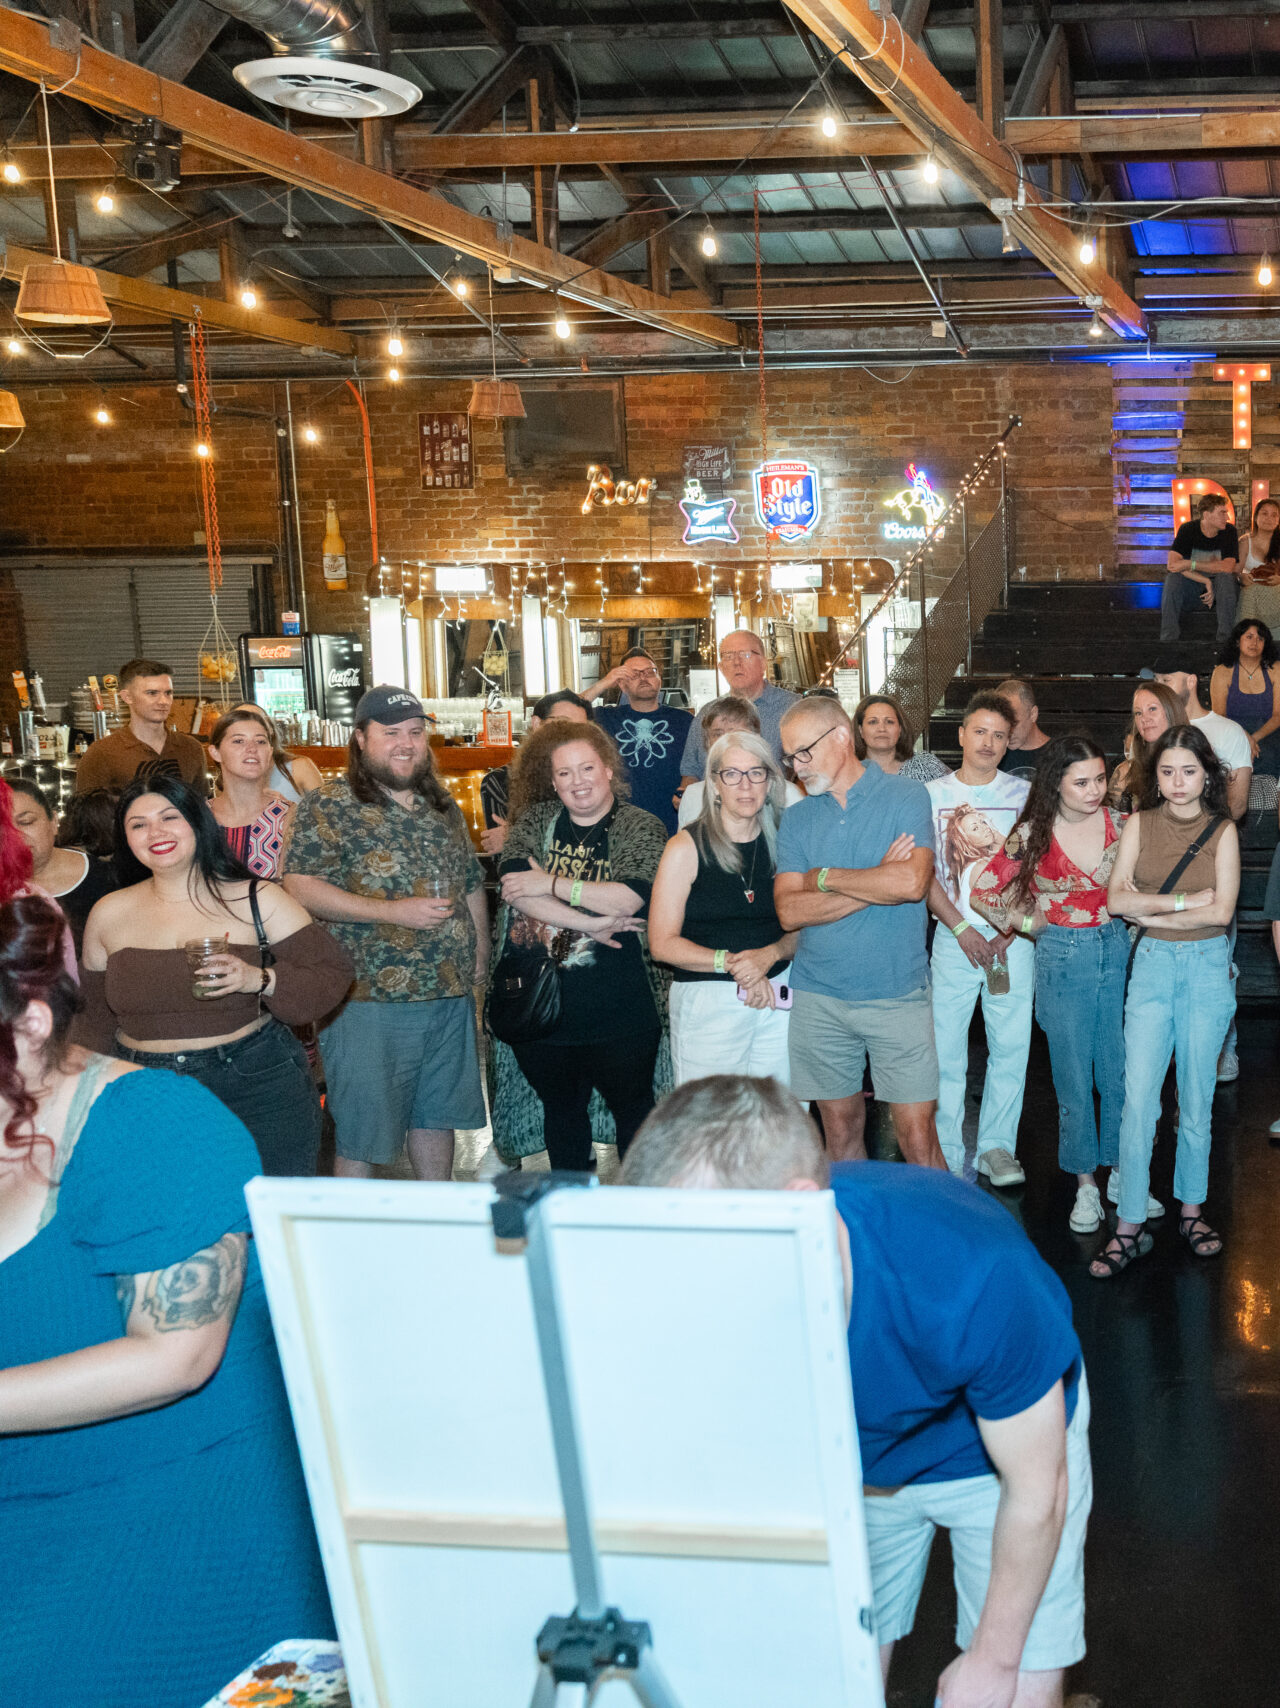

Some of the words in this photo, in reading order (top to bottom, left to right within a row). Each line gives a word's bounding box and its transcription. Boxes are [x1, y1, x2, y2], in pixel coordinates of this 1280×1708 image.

[699, 447, 728, 460] Miller
[582, 463, 657, 514] Bar
[771, 477, 803, 498] Old
[763, 494, 813, 523] Style
[387, 694, 406, 705] CAPE
